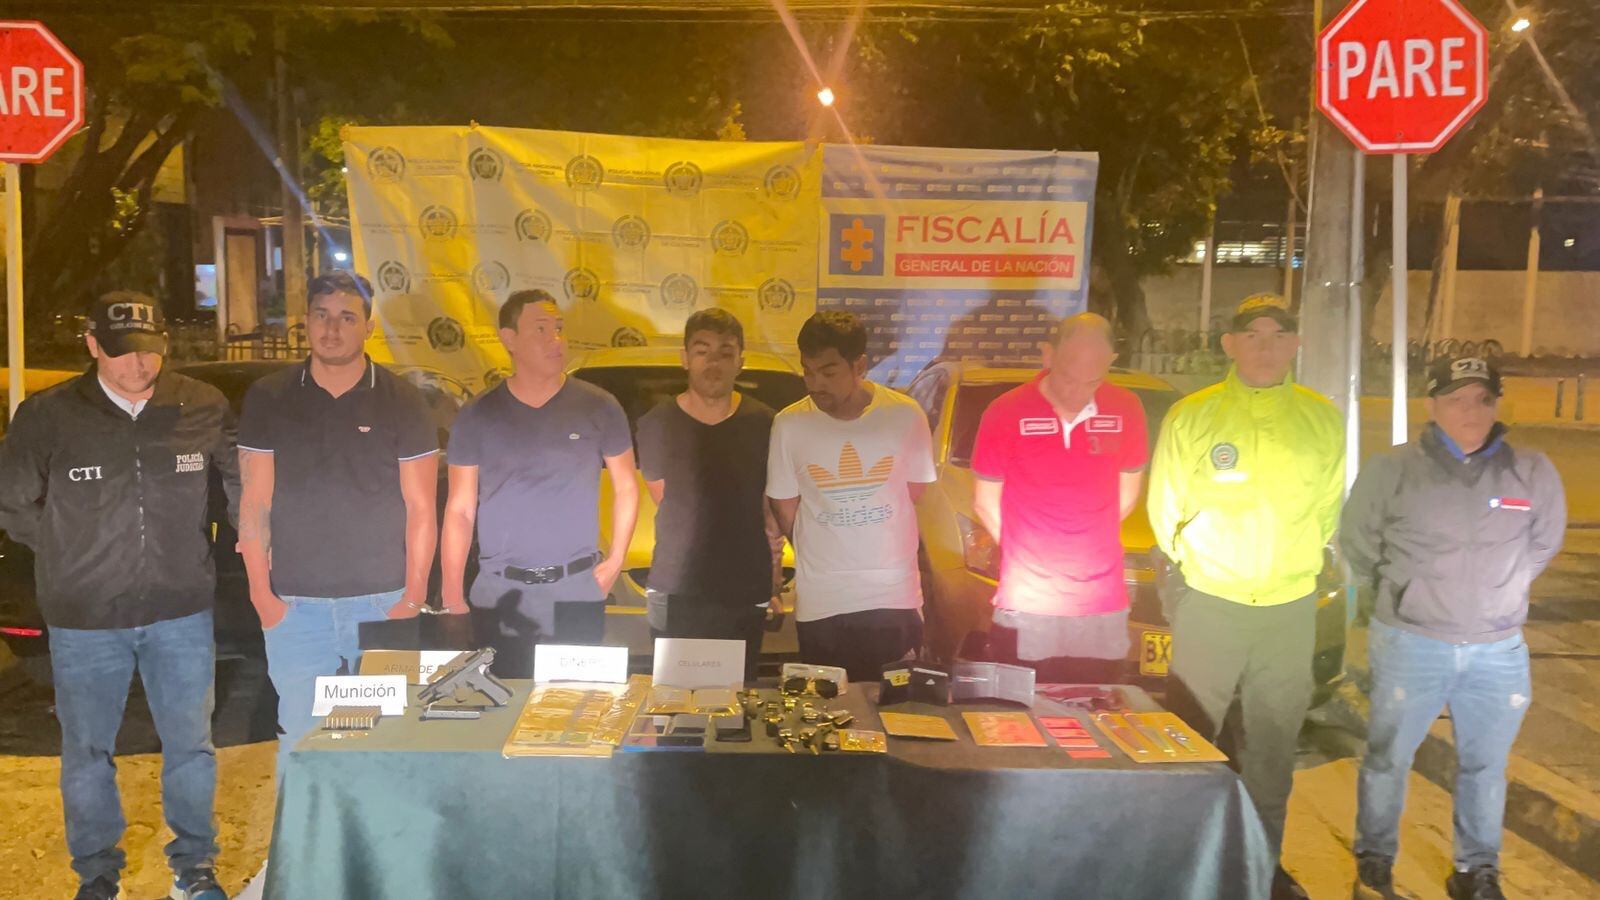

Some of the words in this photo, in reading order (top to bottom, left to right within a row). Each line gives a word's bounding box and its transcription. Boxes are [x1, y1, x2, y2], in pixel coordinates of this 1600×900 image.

[1338, 37, 1467, 100] PARE
[896, 209, 1075, 244] FISCALÍA
[899, 258, 967, 272] GENERAL
[971, 260, 990, 273] DE
[995, 260, 1011, 273] LA
[1015, 257, 1070, 273] NACIÓN
[107, 302, 154, 323] CTI
[175, 451, 204, 464] POLICÍA
[68, 466, 103, 482] CTI
[816, 503, 894, 528] adidas
[418, 664, 434, 675] DE
[677, 659, 722, 667] CELULARES
[324, 683, 396, 699] Munición
